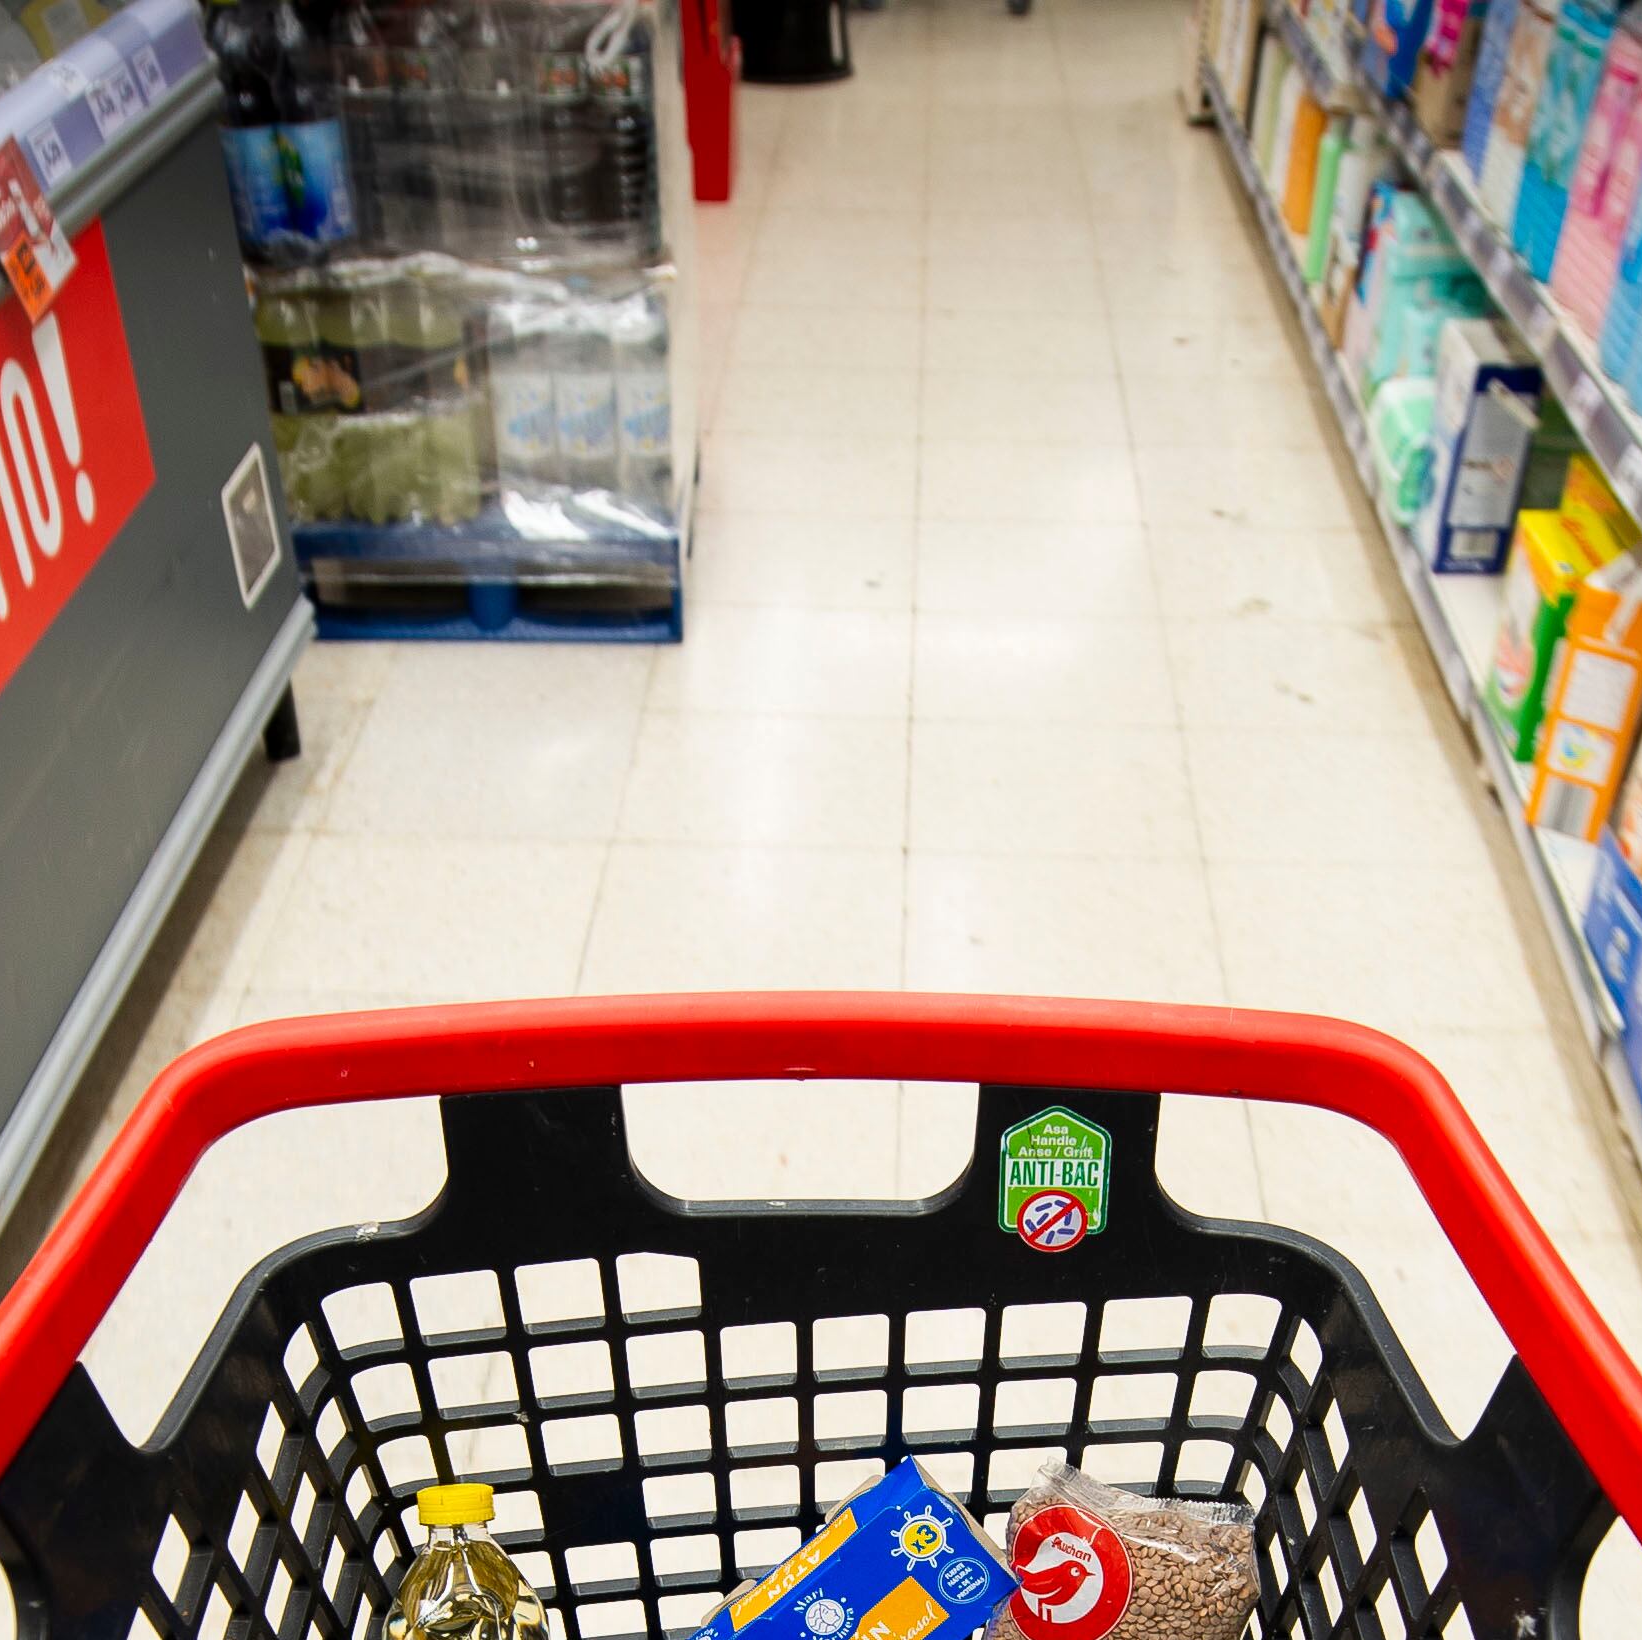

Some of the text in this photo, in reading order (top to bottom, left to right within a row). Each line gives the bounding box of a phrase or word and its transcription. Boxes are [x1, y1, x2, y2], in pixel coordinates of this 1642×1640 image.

[1043, 1124, 1069, 1135] Asa
[1031, 1134, 1077, 1146] Handle
[1018, 1146, 1052, 1157] Anse
[1010, 1161, 1099, 1187] ANTI-BAC
[1051, 1536, 1093, 1563] Auchan
